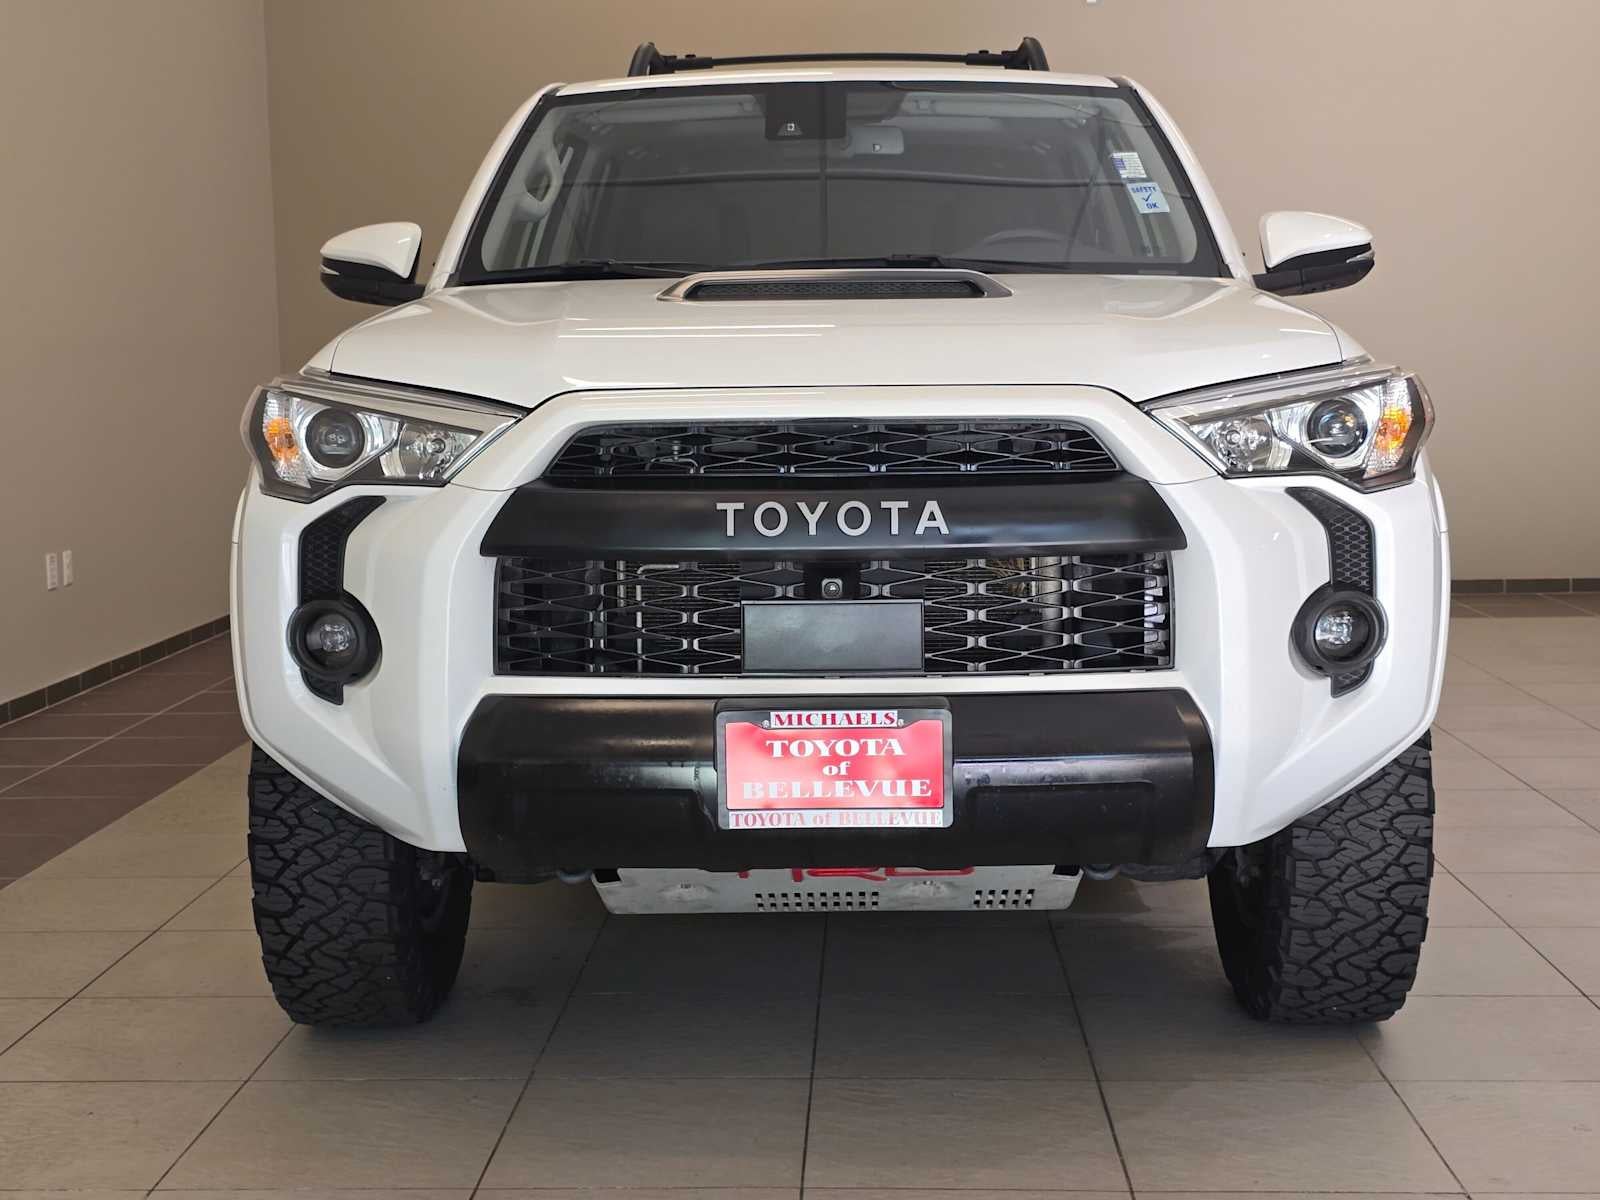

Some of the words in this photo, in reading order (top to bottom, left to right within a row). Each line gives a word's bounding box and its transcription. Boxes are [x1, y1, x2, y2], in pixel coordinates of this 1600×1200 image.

[716, 500, 950, 537] TOYOTA
[773, 711, 895, 727] MICHAELS
[765, 738, 906, 759] TOYOTA
[822, 760, 852, 776] of
[742, 779, 932, 800] BELLEVUE
[731, 812, 807, 828] TOYOTA
[812, 811, 831, 826] of
[838, 811, 942, 826] BELLEVUE
